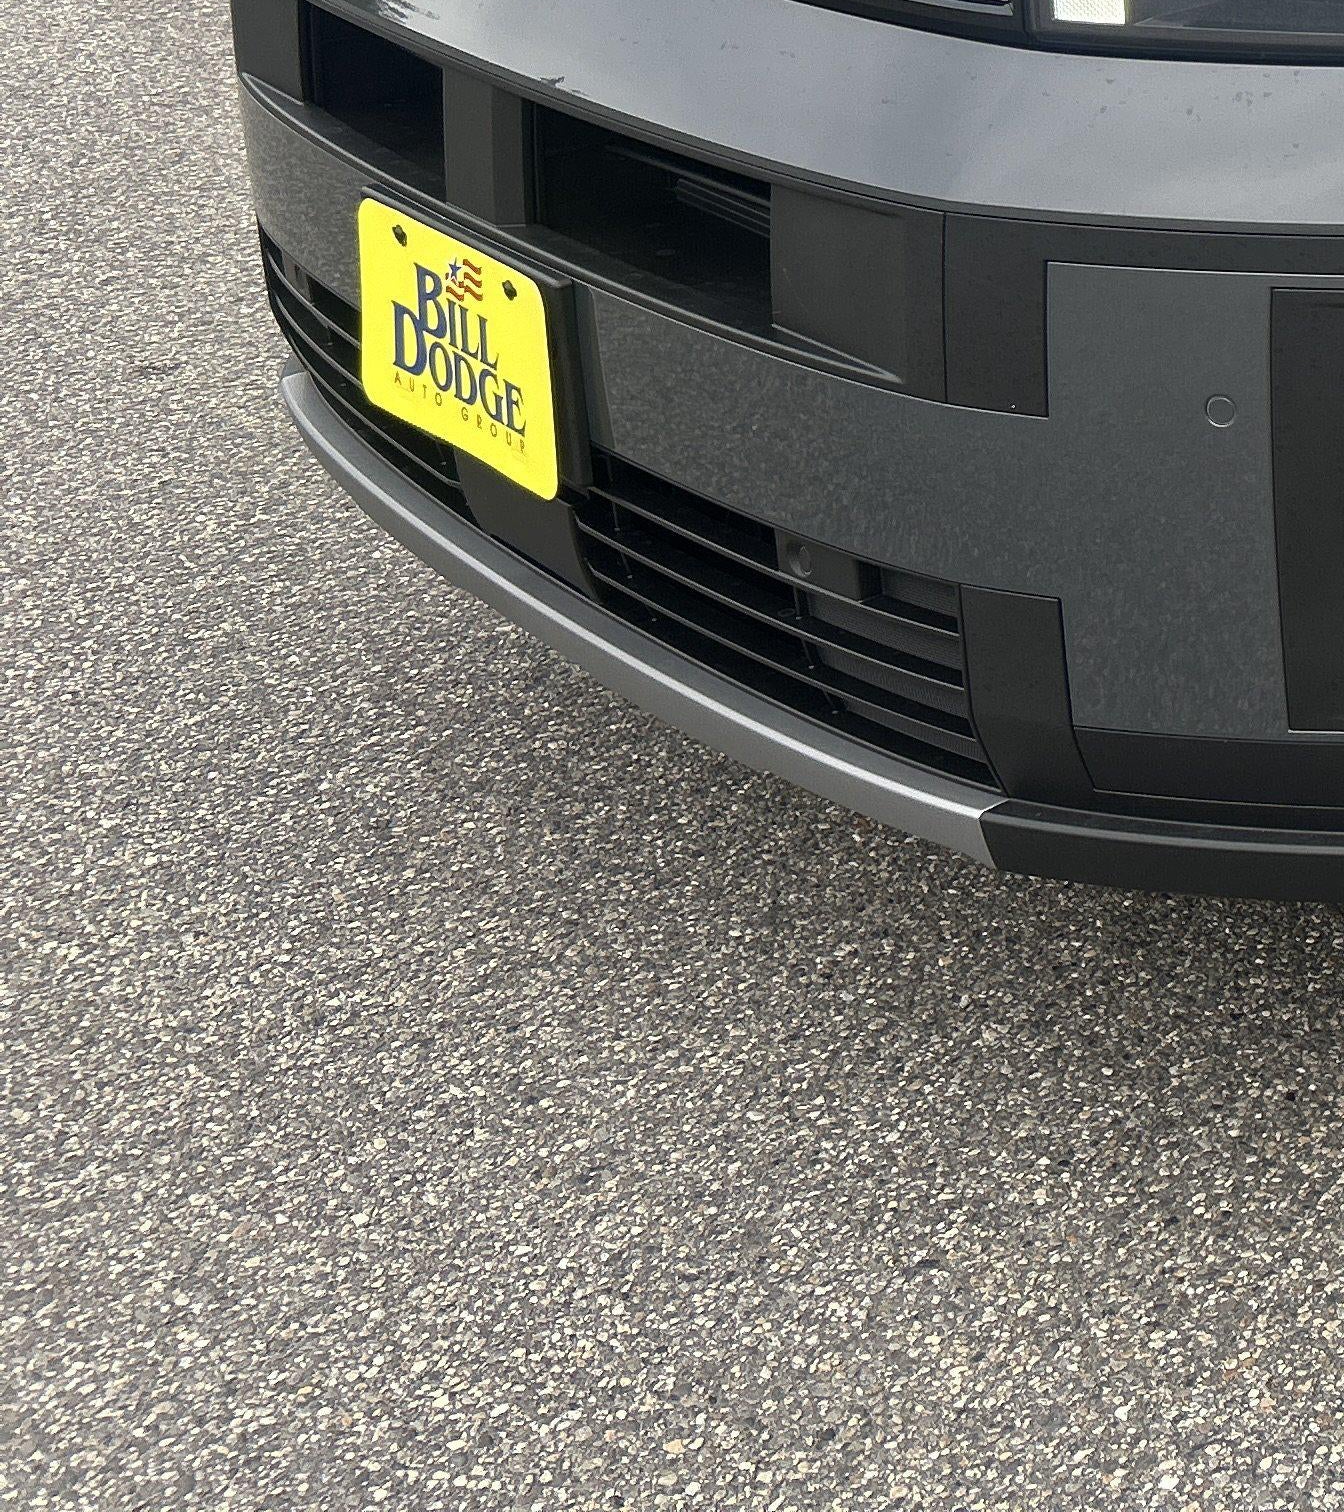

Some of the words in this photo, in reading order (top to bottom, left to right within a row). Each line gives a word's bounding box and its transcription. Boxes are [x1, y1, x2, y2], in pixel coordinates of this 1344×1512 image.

[391, 300, 527, 437] DODGE
[394, 372, 443, 407] AUTO
[461, 407, 526, 454] GROUP
